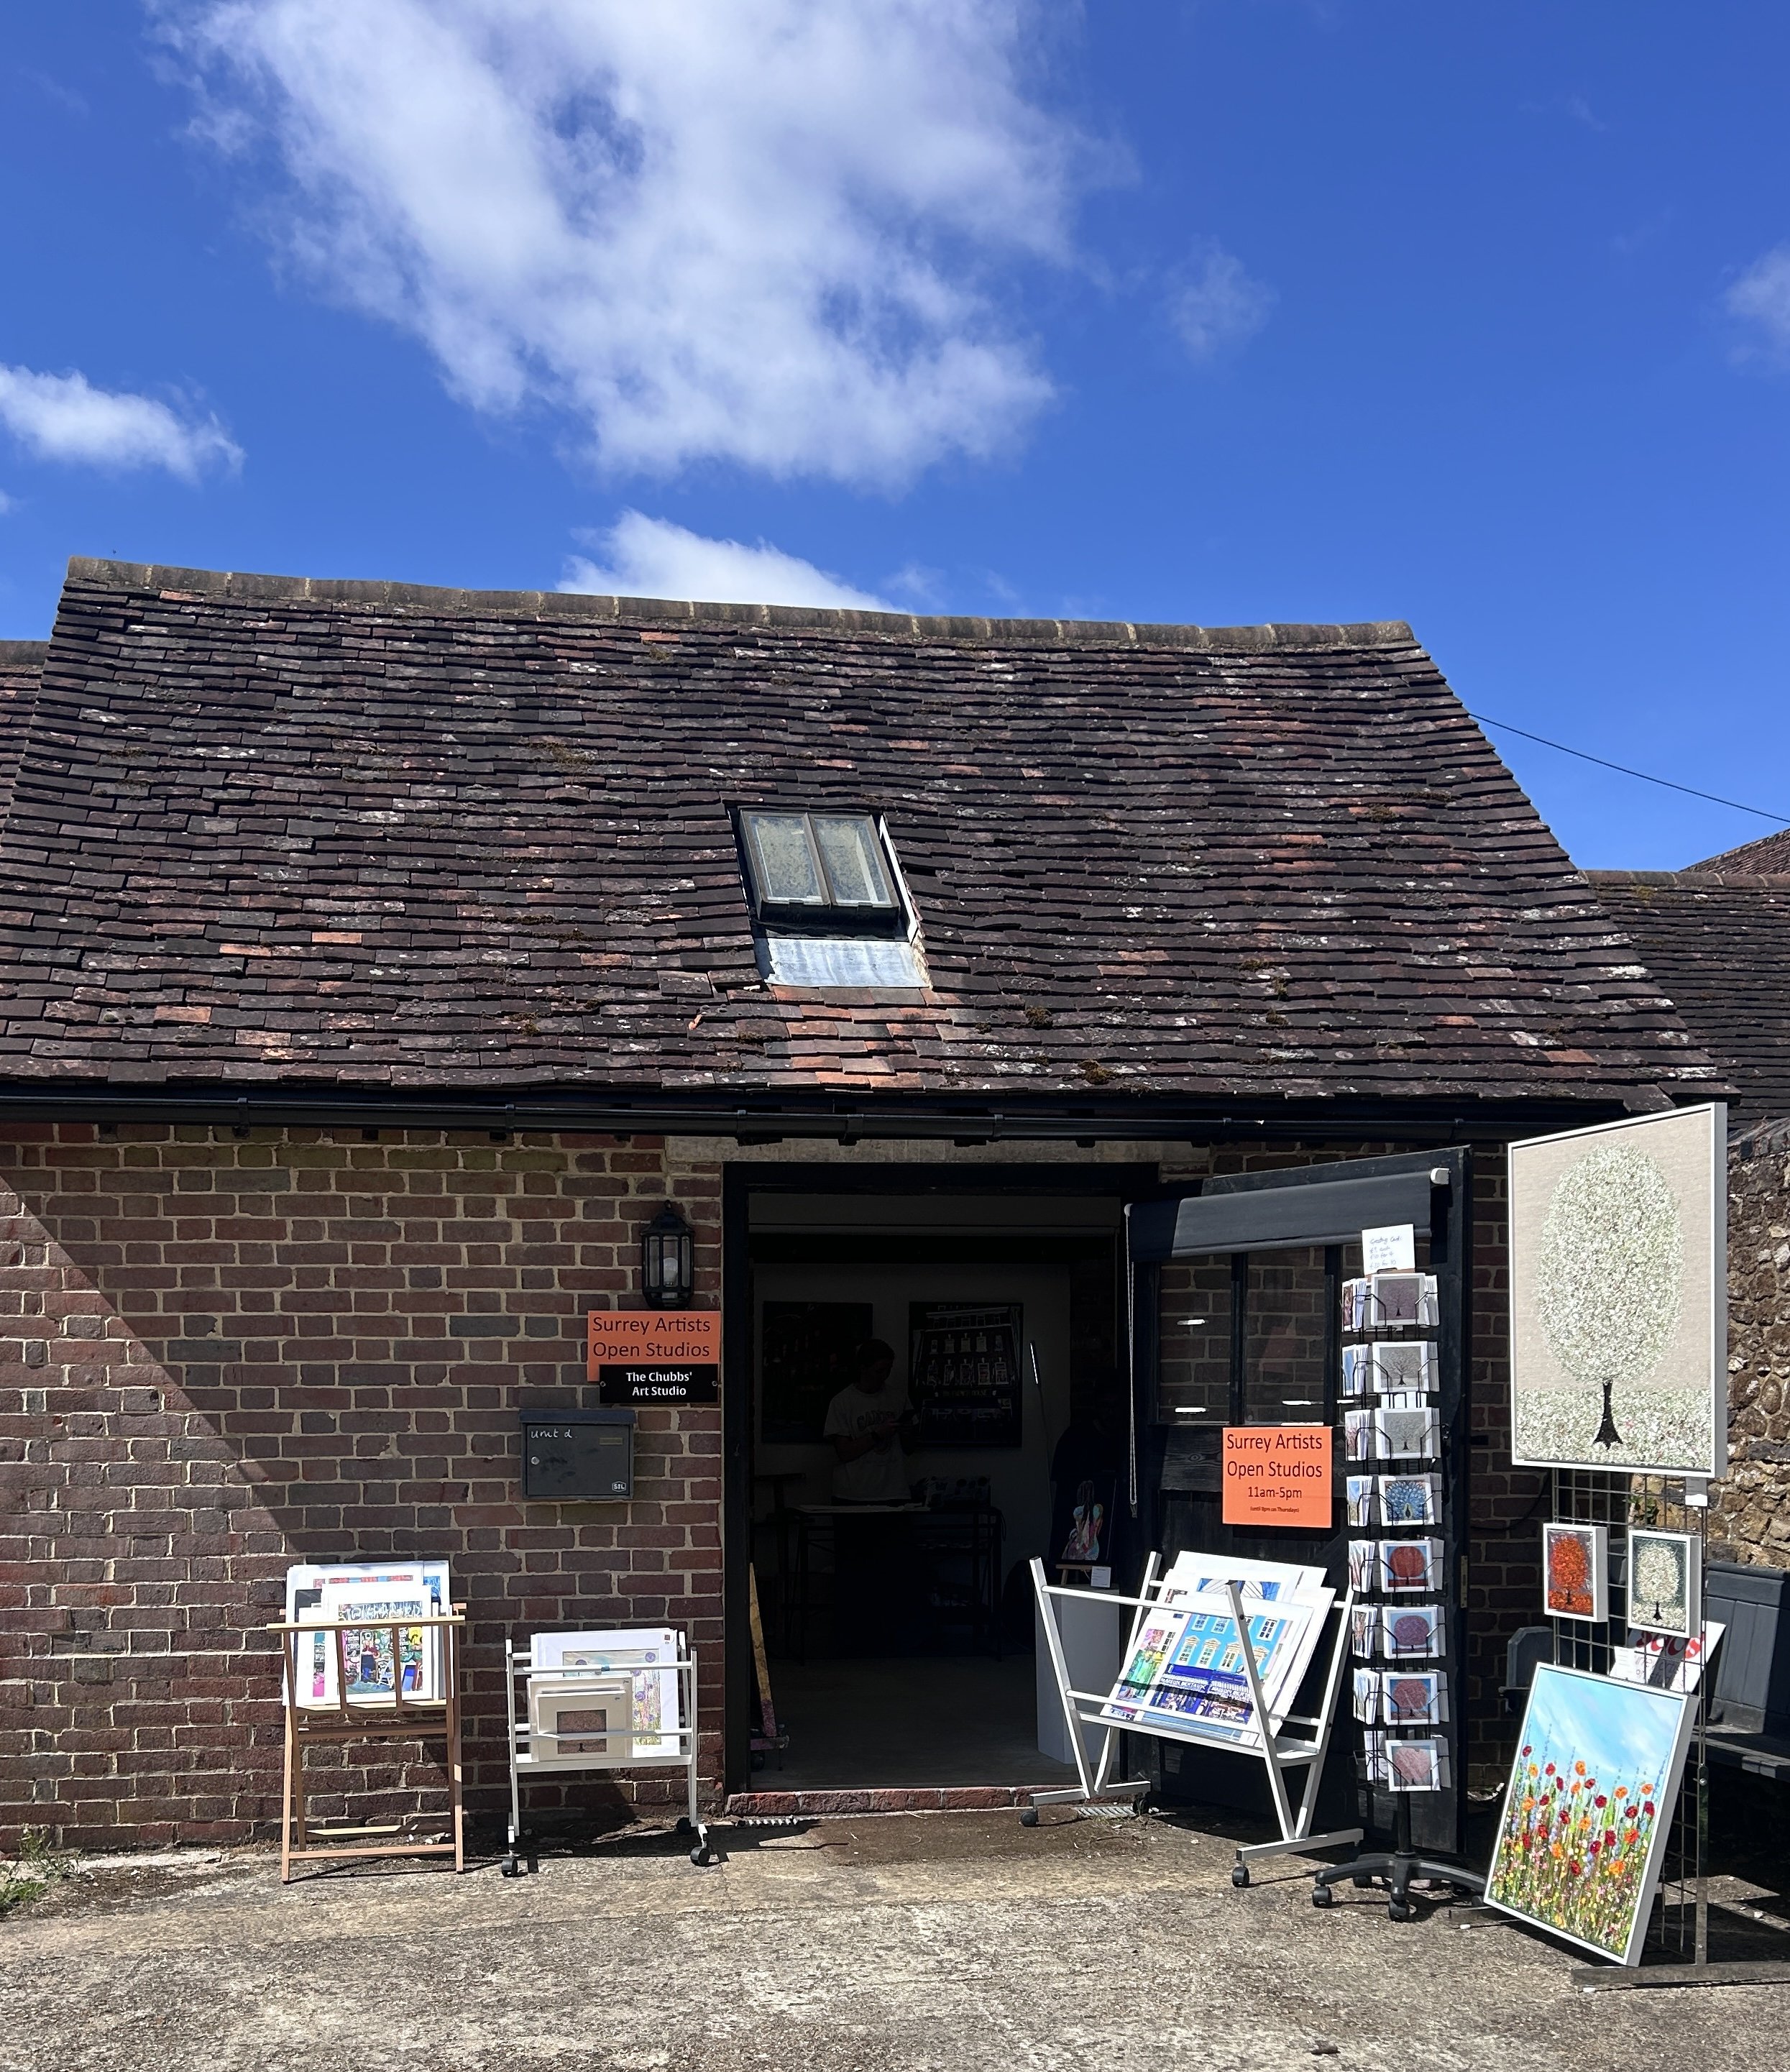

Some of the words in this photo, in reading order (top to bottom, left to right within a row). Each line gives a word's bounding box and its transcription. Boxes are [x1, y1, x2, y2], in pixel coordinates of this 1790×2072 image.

[592, 1316, 650, 1335] Surrey
[654, 1317, 711, 1332] Artists
[593, 1342, 640, 1360] Open
[646, 1342, 710, 1357] Studios
[625, 1372, 646, 1382] The
[648, 1371, 692, 1382] Chubbs'
[632, 1387, 649, 1396] Art
[651, 1386, 687, 1396] Studio
[1226, 1434, 1271, 1453] Surrey
[1275, 1434, 1323, 1449] Artists
[1227, 1461, 1264, 1480] Open
[1268, 1461, 1323, 1477] Studios
[1248, 1486, 1302, 1500] 11am-5pm
